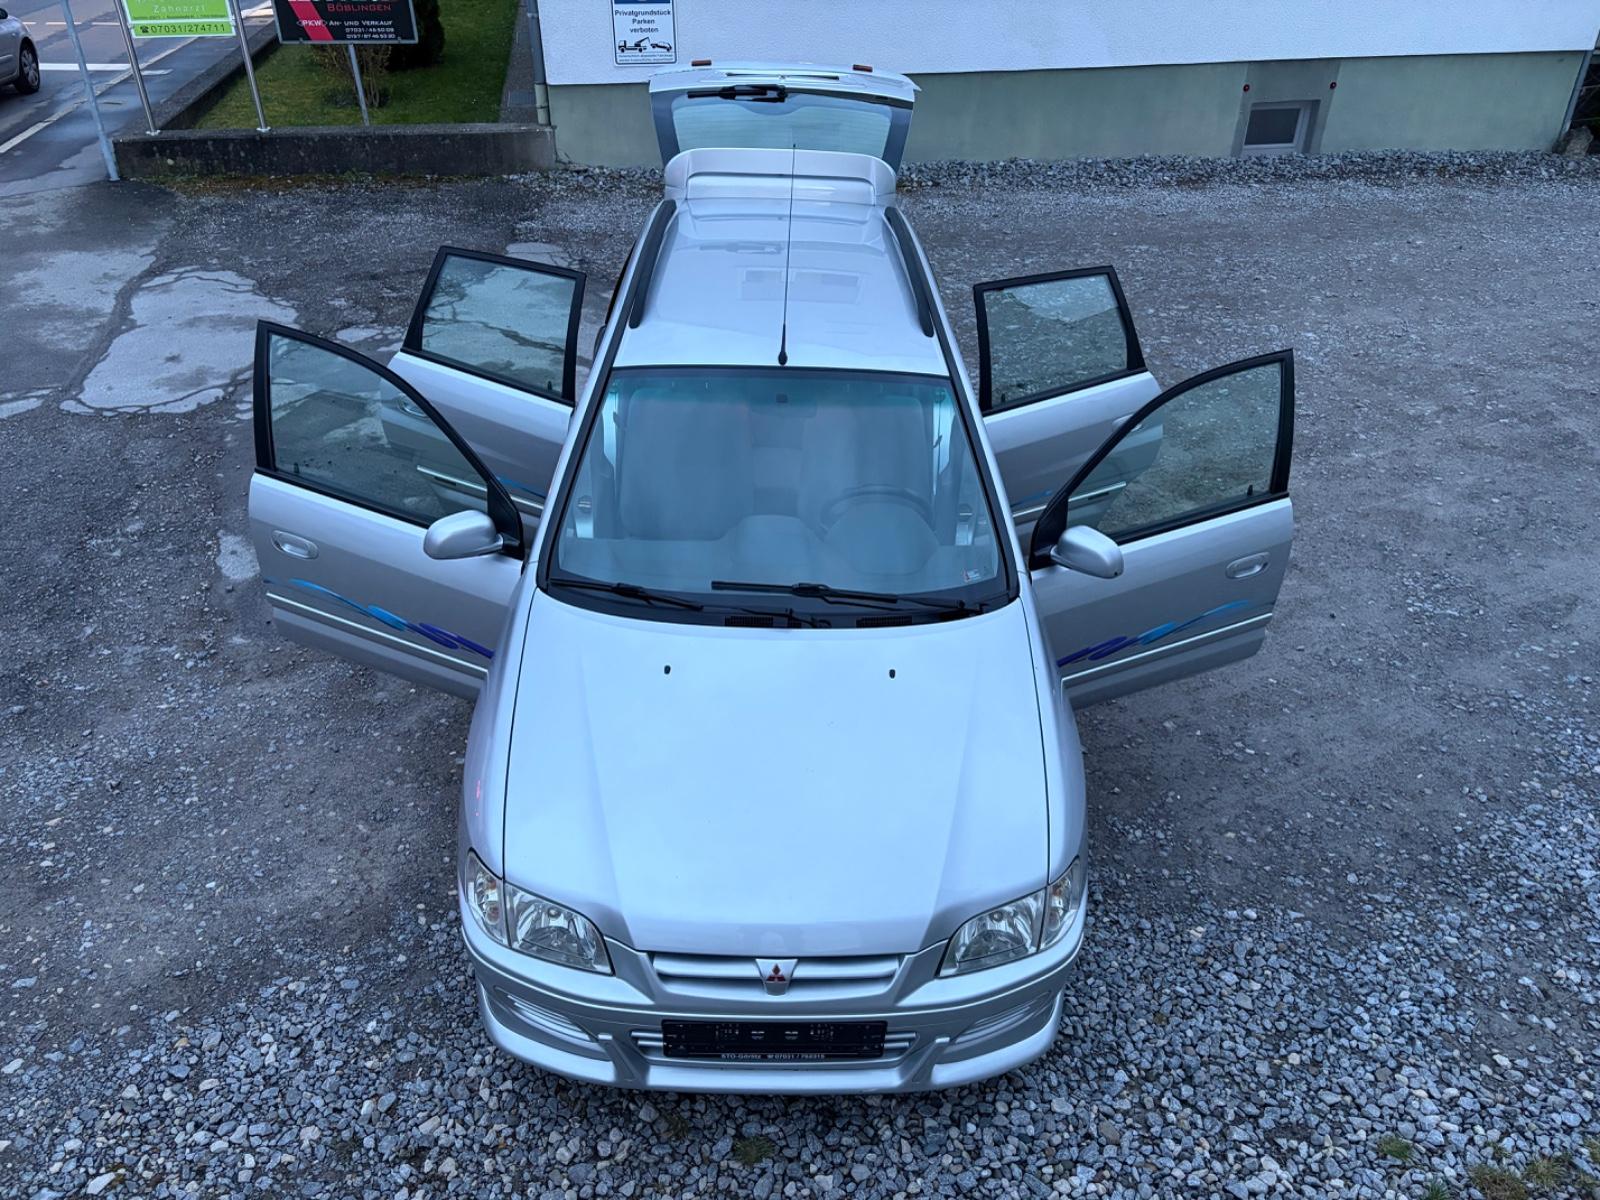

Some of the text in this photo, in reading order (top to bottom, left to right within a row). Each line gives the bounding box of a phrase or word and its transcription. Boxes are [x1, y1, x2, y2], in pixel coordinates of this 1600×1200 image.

[153, 5, 206, 14] Zahnarzt
[327, 3, 391, 12] BÖBLINGEN
[614, 9, 671, 17] Privatgrundstück
[150, 24, 225, 33] 07031/274711
